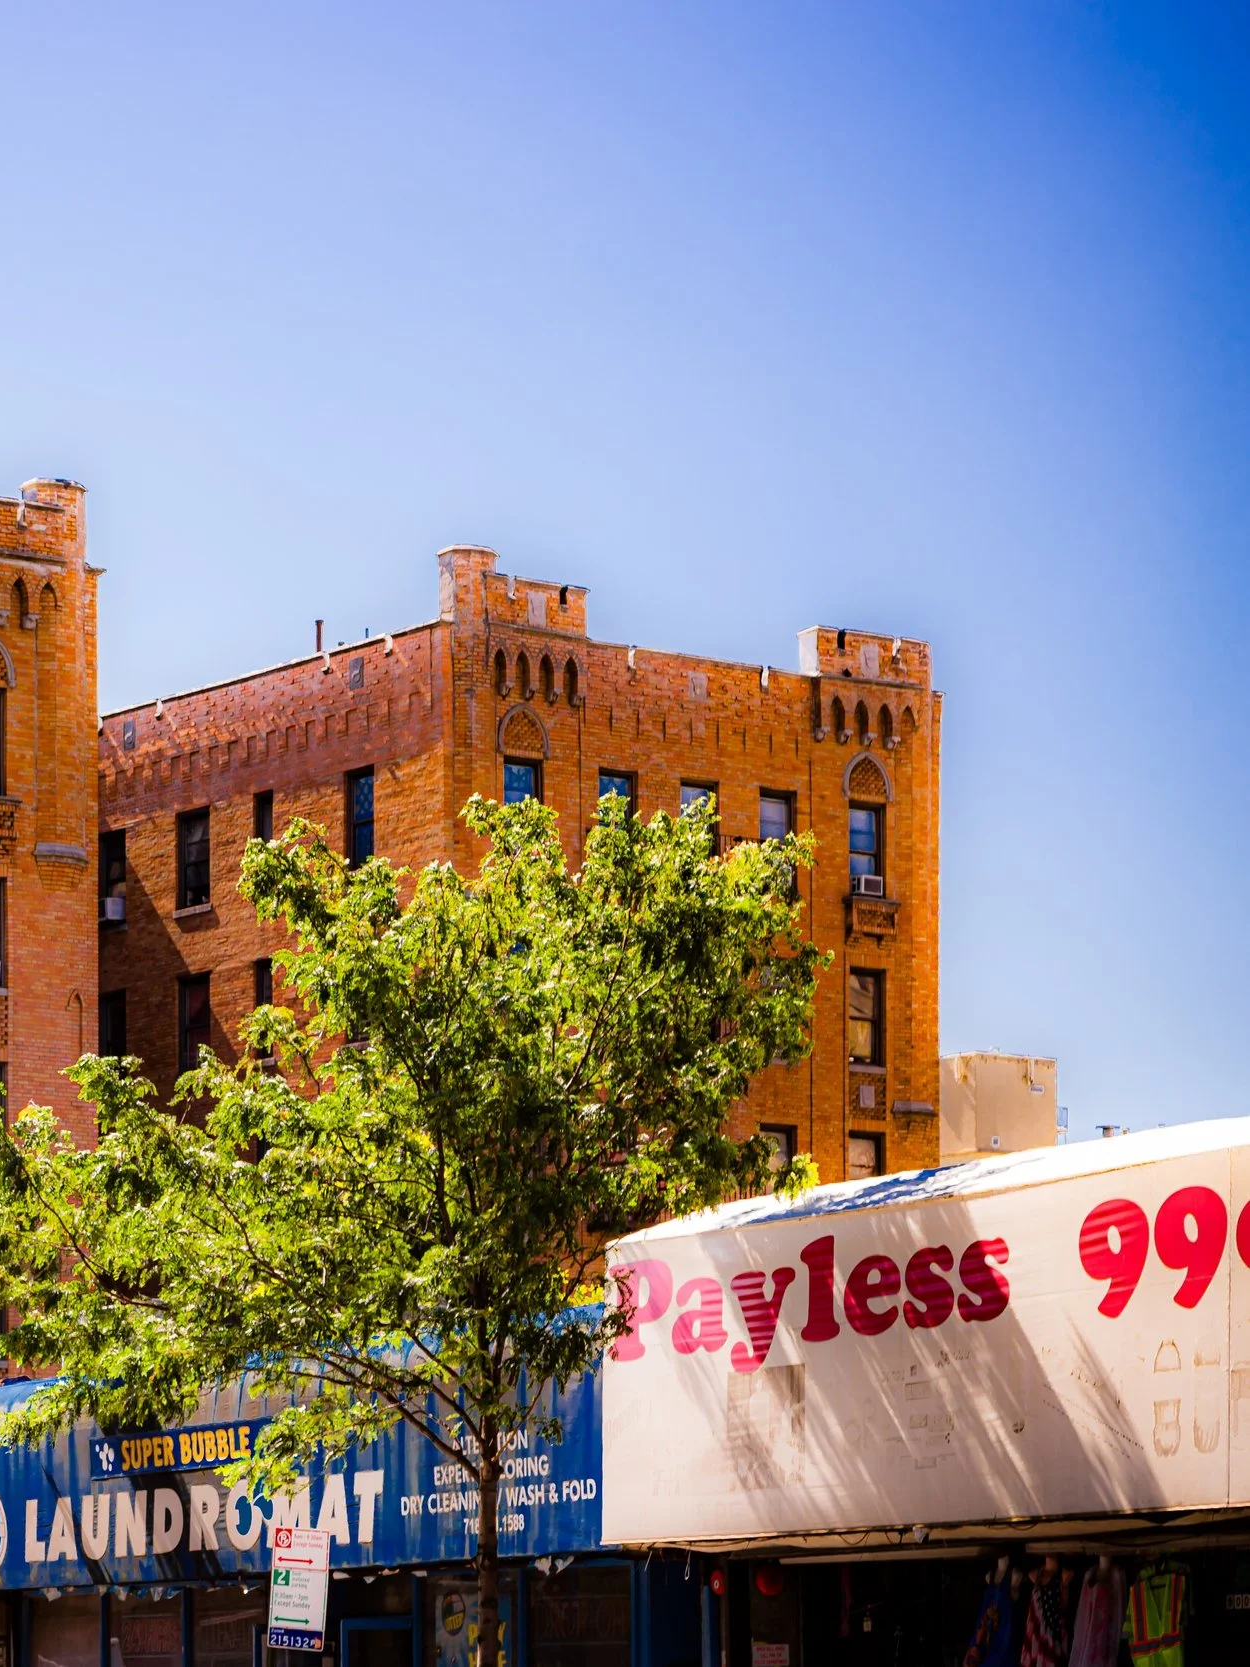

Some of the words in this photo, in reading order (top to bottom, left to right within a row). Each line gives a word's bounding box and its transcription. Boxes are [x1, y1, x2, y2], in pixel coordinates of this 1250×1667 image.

[609, 1235, 1011, 1374] Payless
[122, 1436, 176, 1471] SUPER
[180, 1426, 251, 1464] BUBBLE
[452, 1430, 528, 1456] ALTETION
[25, 1469, 384, 1563] LAUNDROMAT
[401, 1495, 424, 1516] DRY
[428, 1490, 481, 1515] CLEANIN
[506, 1483, 545, 1507] WASH
[549, 1483, 558, 1503] &
[562, 1478, 596, 1502] FOLD
[277, 1570, 286, 1585] 2
[270, 1634, 309, 1649] 215132
